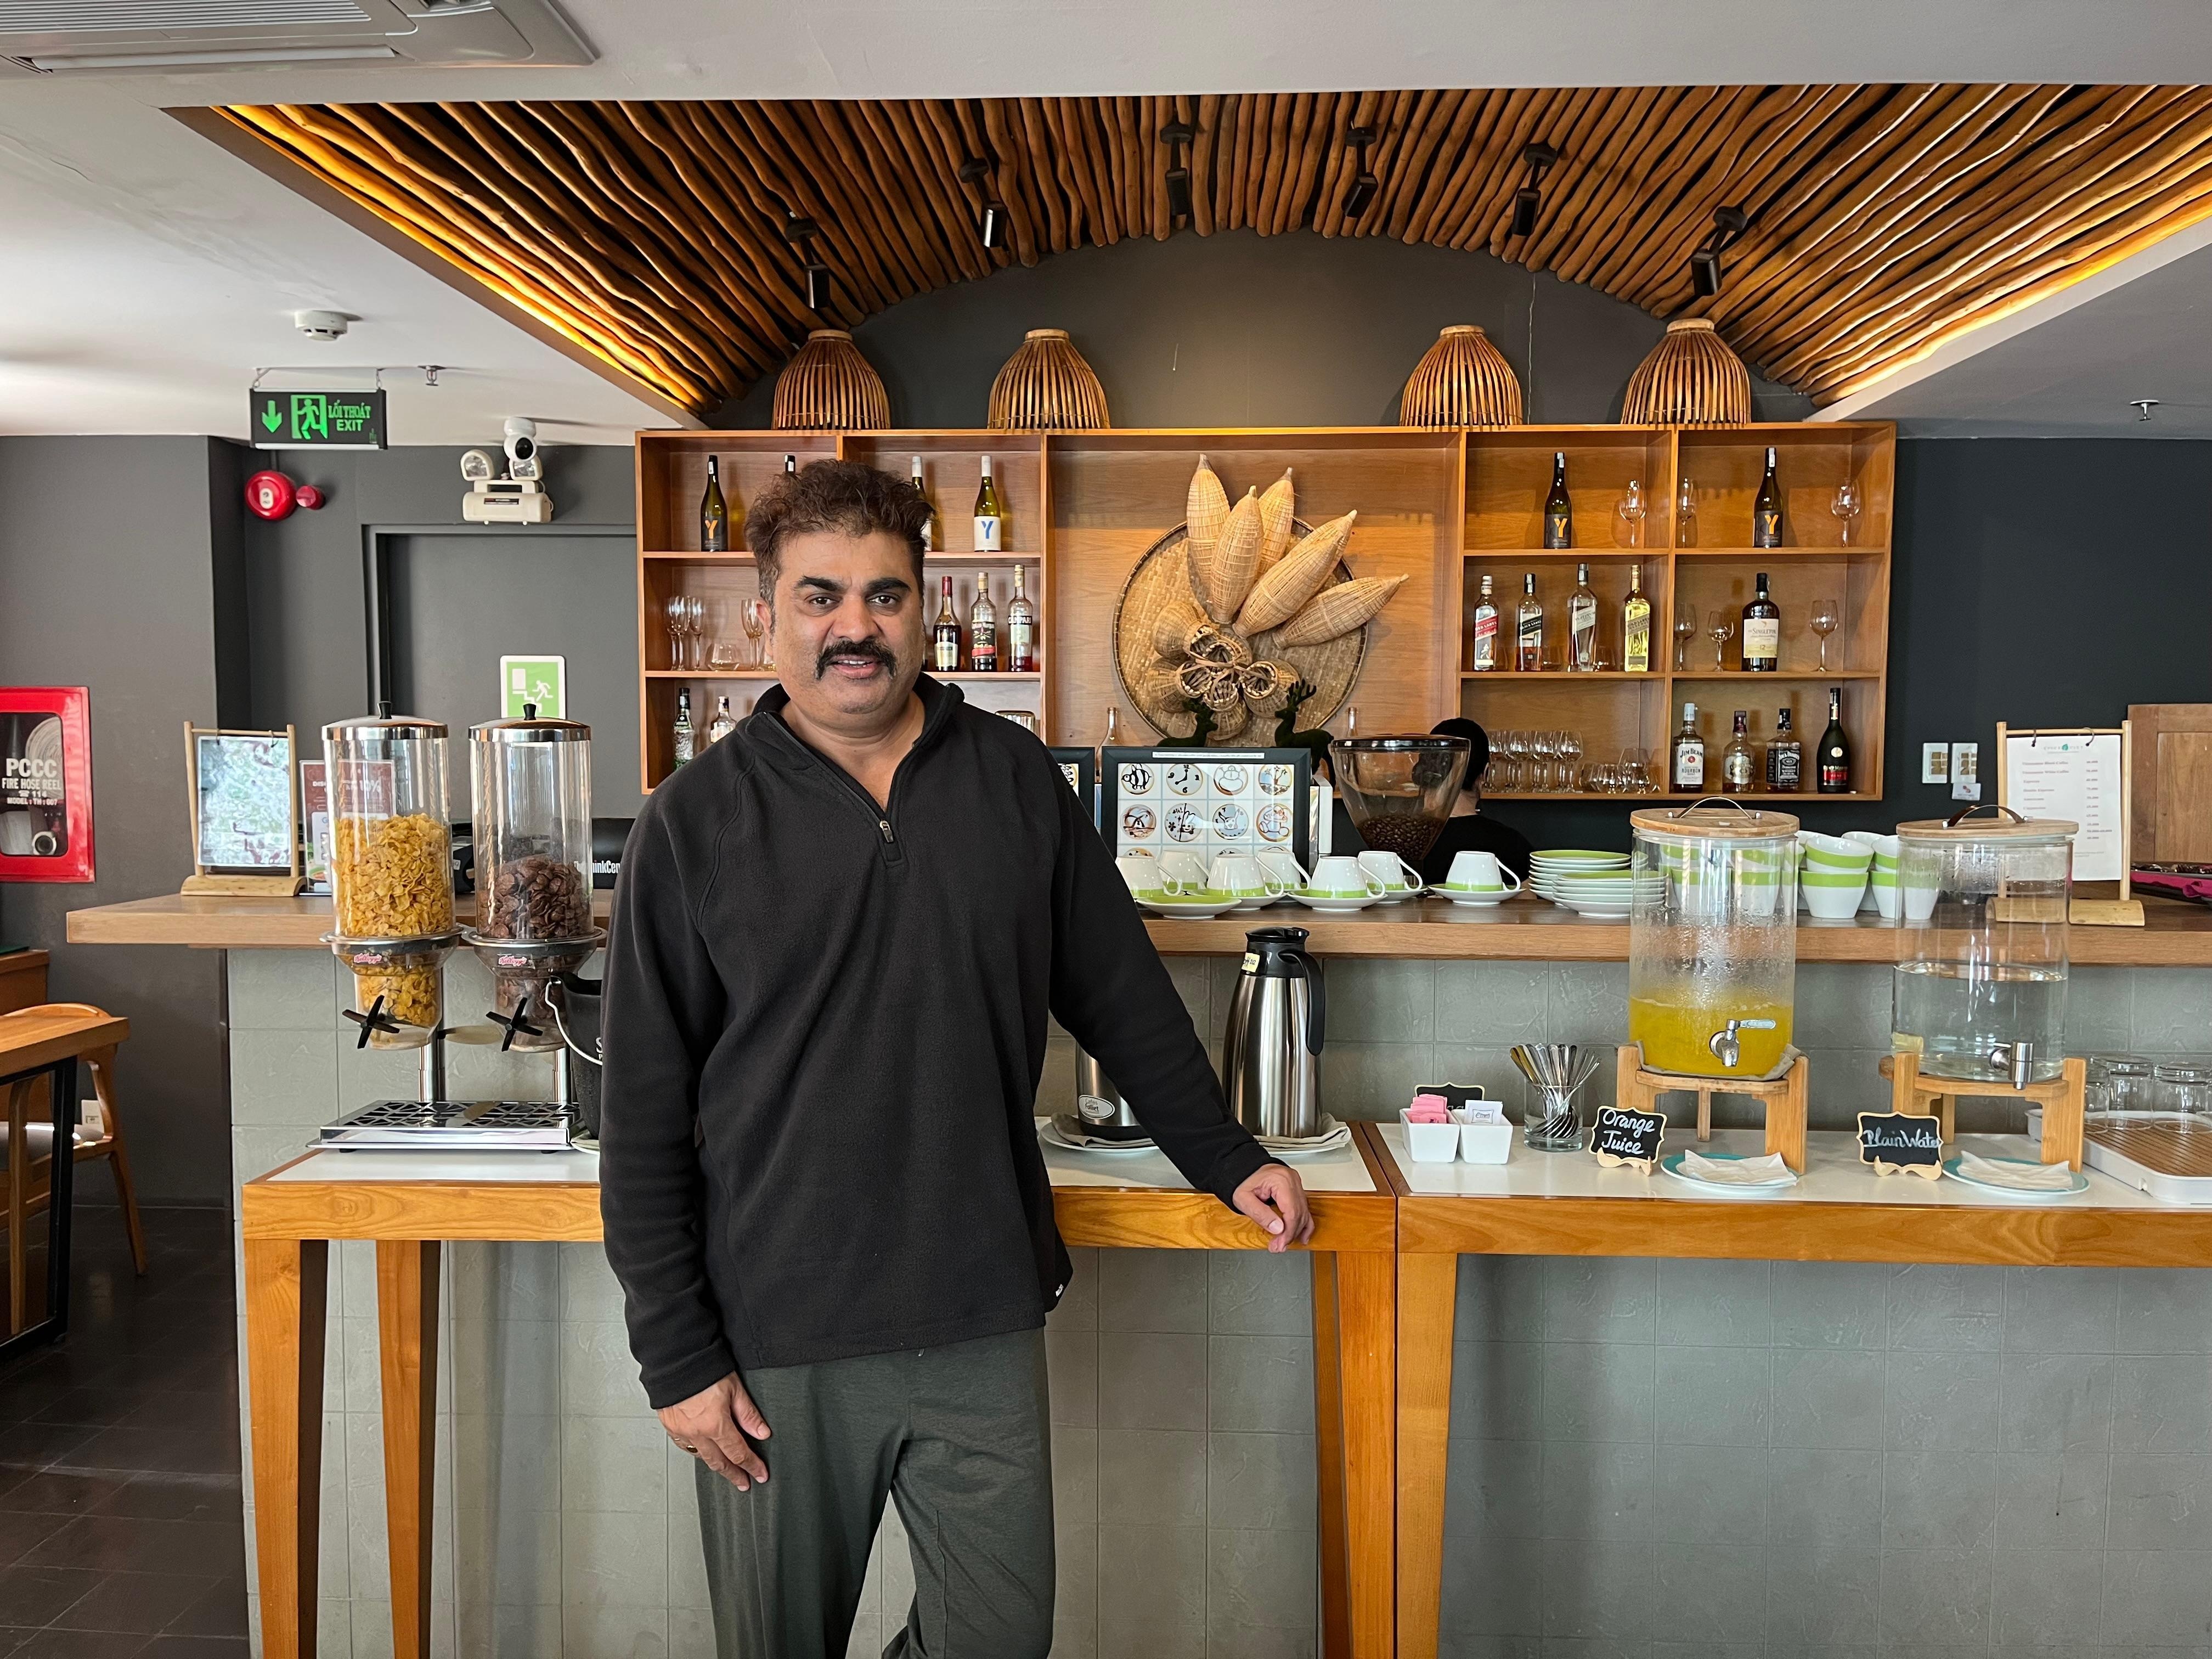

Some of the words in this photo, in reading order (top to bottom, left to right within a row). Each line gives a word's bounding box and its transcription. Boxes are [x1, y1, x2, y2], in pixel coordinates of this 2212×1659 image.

[336, 419, 363, 432] EXIT
[6, 758, 57, 778] PCCC
[2, 778, 19, 789] FIRE
[20, 778, 41, 789] HOSE
[42, 778, 61, 790] REEL
[1602, 1109, 1656, 1139] Orange
[1601, 1130, 1645, 1155] Juice
[1863, 1126, 1905, 1148] Plain
